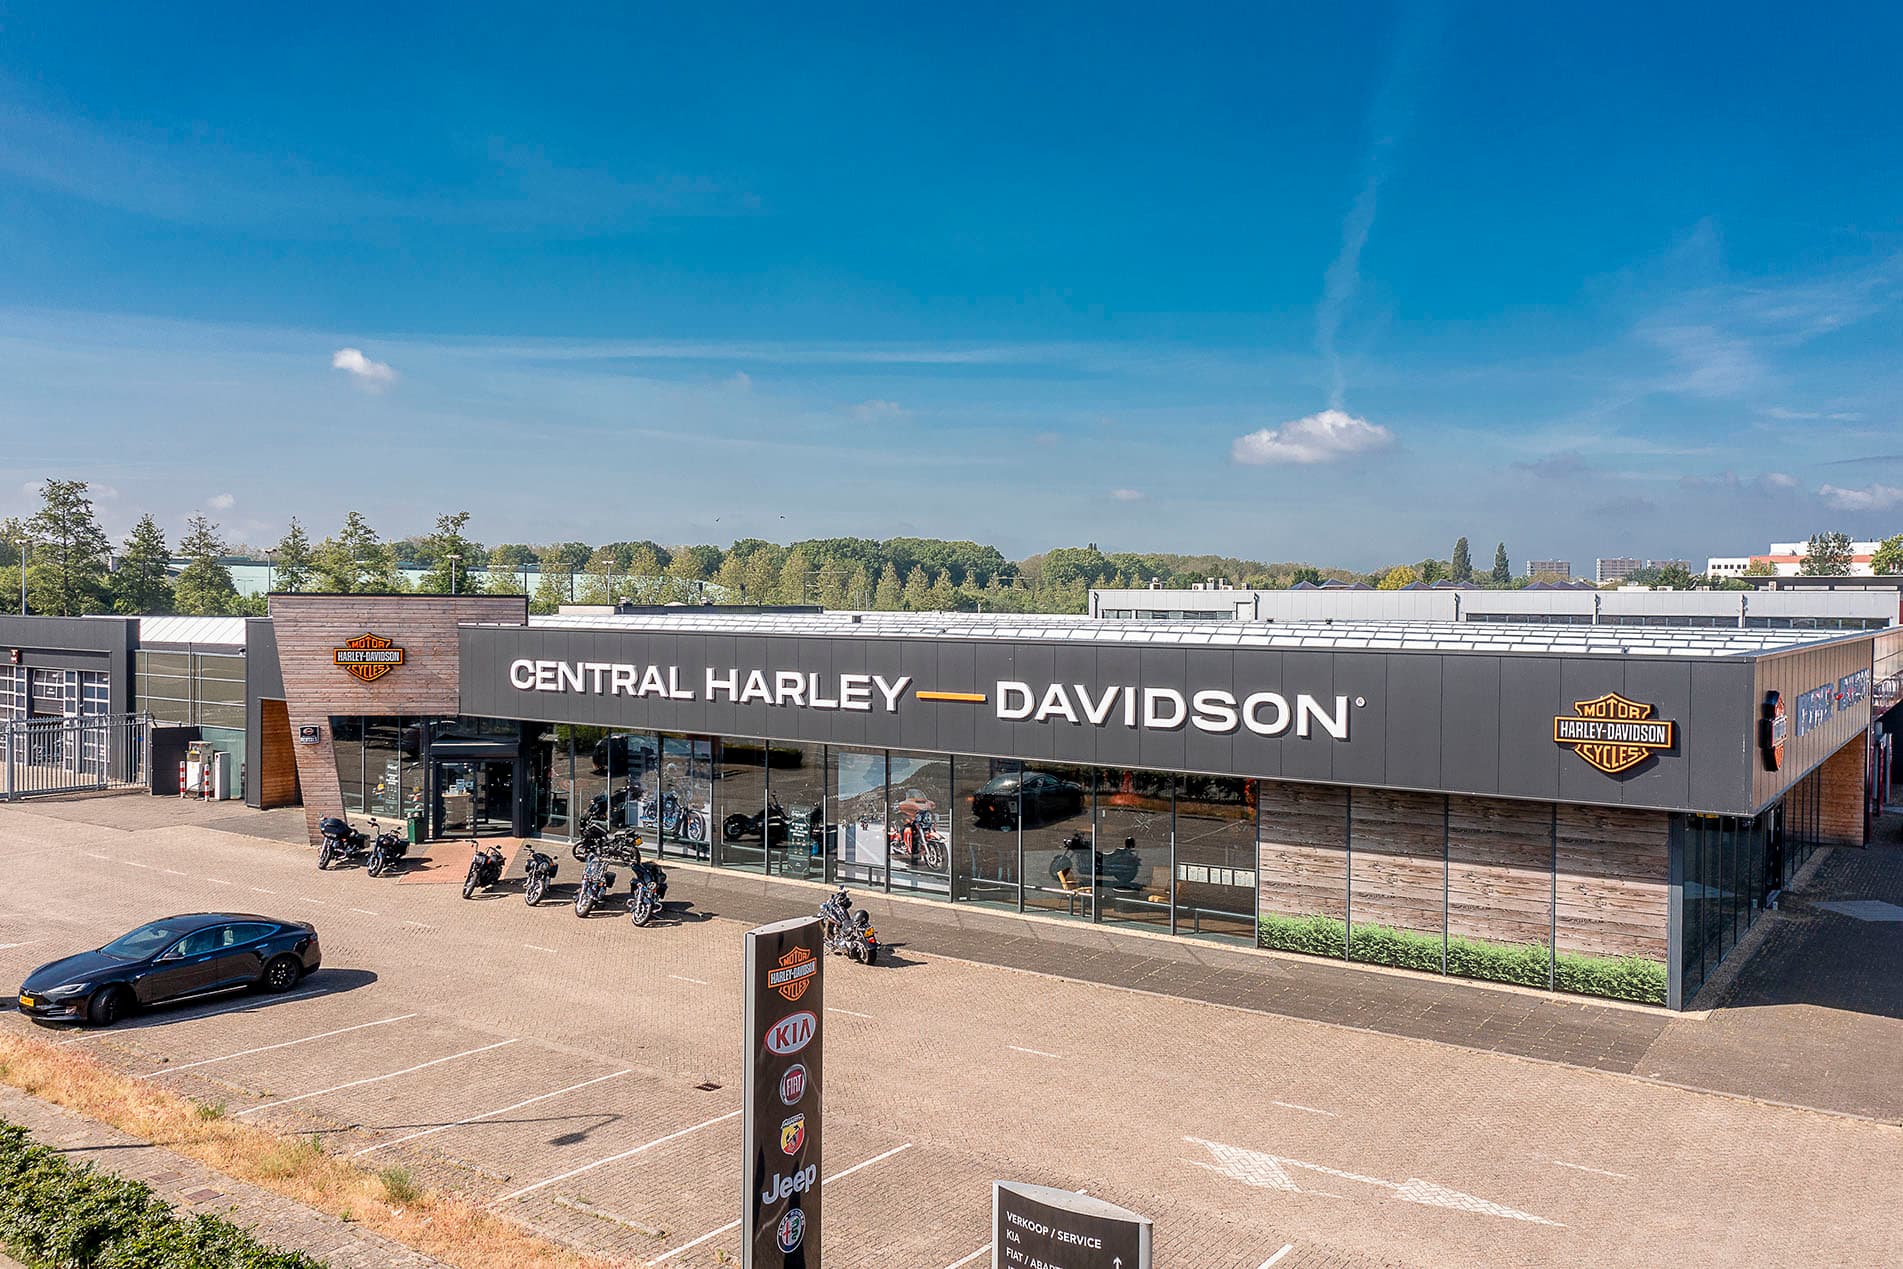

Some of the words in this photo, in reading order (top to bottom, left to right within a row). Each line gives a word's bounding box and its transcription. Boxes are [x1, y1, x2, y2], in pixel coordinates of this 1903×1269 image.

[351, 636, 385, 648] MOTOR
[337, 651, 400, 662] HARLEY-DAVIDSON
[351, 664, 386, 679] CYCLES
[509, 659, 695, 700] CENTRAL
[1583, 698, 1641, 719] MOTOR
[1560, 720, 1666, 743] HARLEY-DAVIDSON
[1583, 744, 1643, 769] CYCLES
[783, 949, 808, 966] MOTOR
[770, 960, 815, 985] HARLEY-DAVIDSON
[782, 979, 808, 998] CYCLES
[775, 1017, 811, 1049] KIA
[786, 1073, 802, 1097] FIAT
[762, 1163, 817, 1205] Jeep
[1006, 1211, 1049, 1236] VERKOOP
[1057, 1230, 1102, 1249] SERVICE
[1006, 1228, 1021, 1244] KIA
[1006, 1246, 1023, 1263] FIAT
